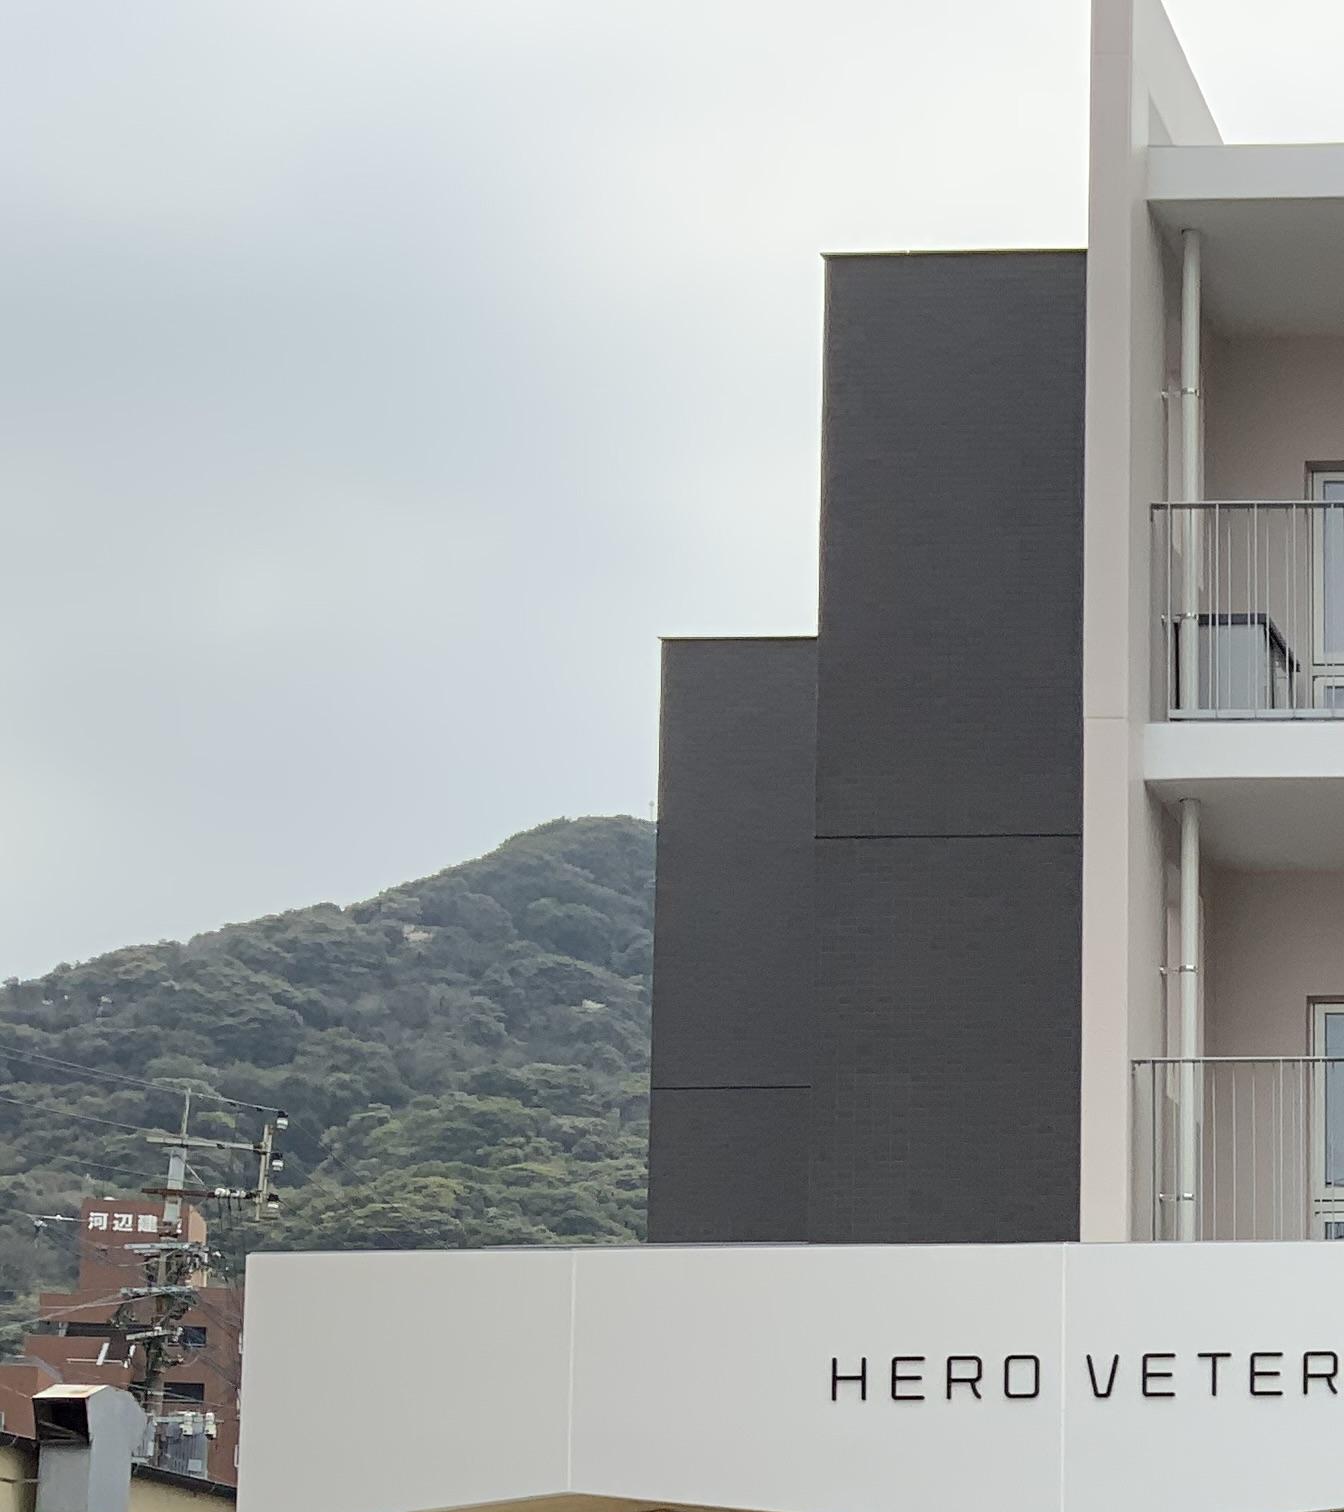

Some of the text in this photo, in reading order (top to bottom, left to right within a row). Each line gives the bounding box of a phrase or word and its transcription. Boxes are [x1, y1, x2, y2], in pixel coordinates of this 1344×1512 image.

[88, 1211, 182, 1234] 河辺建
[831, 1354, 1041, 1402] HERO
